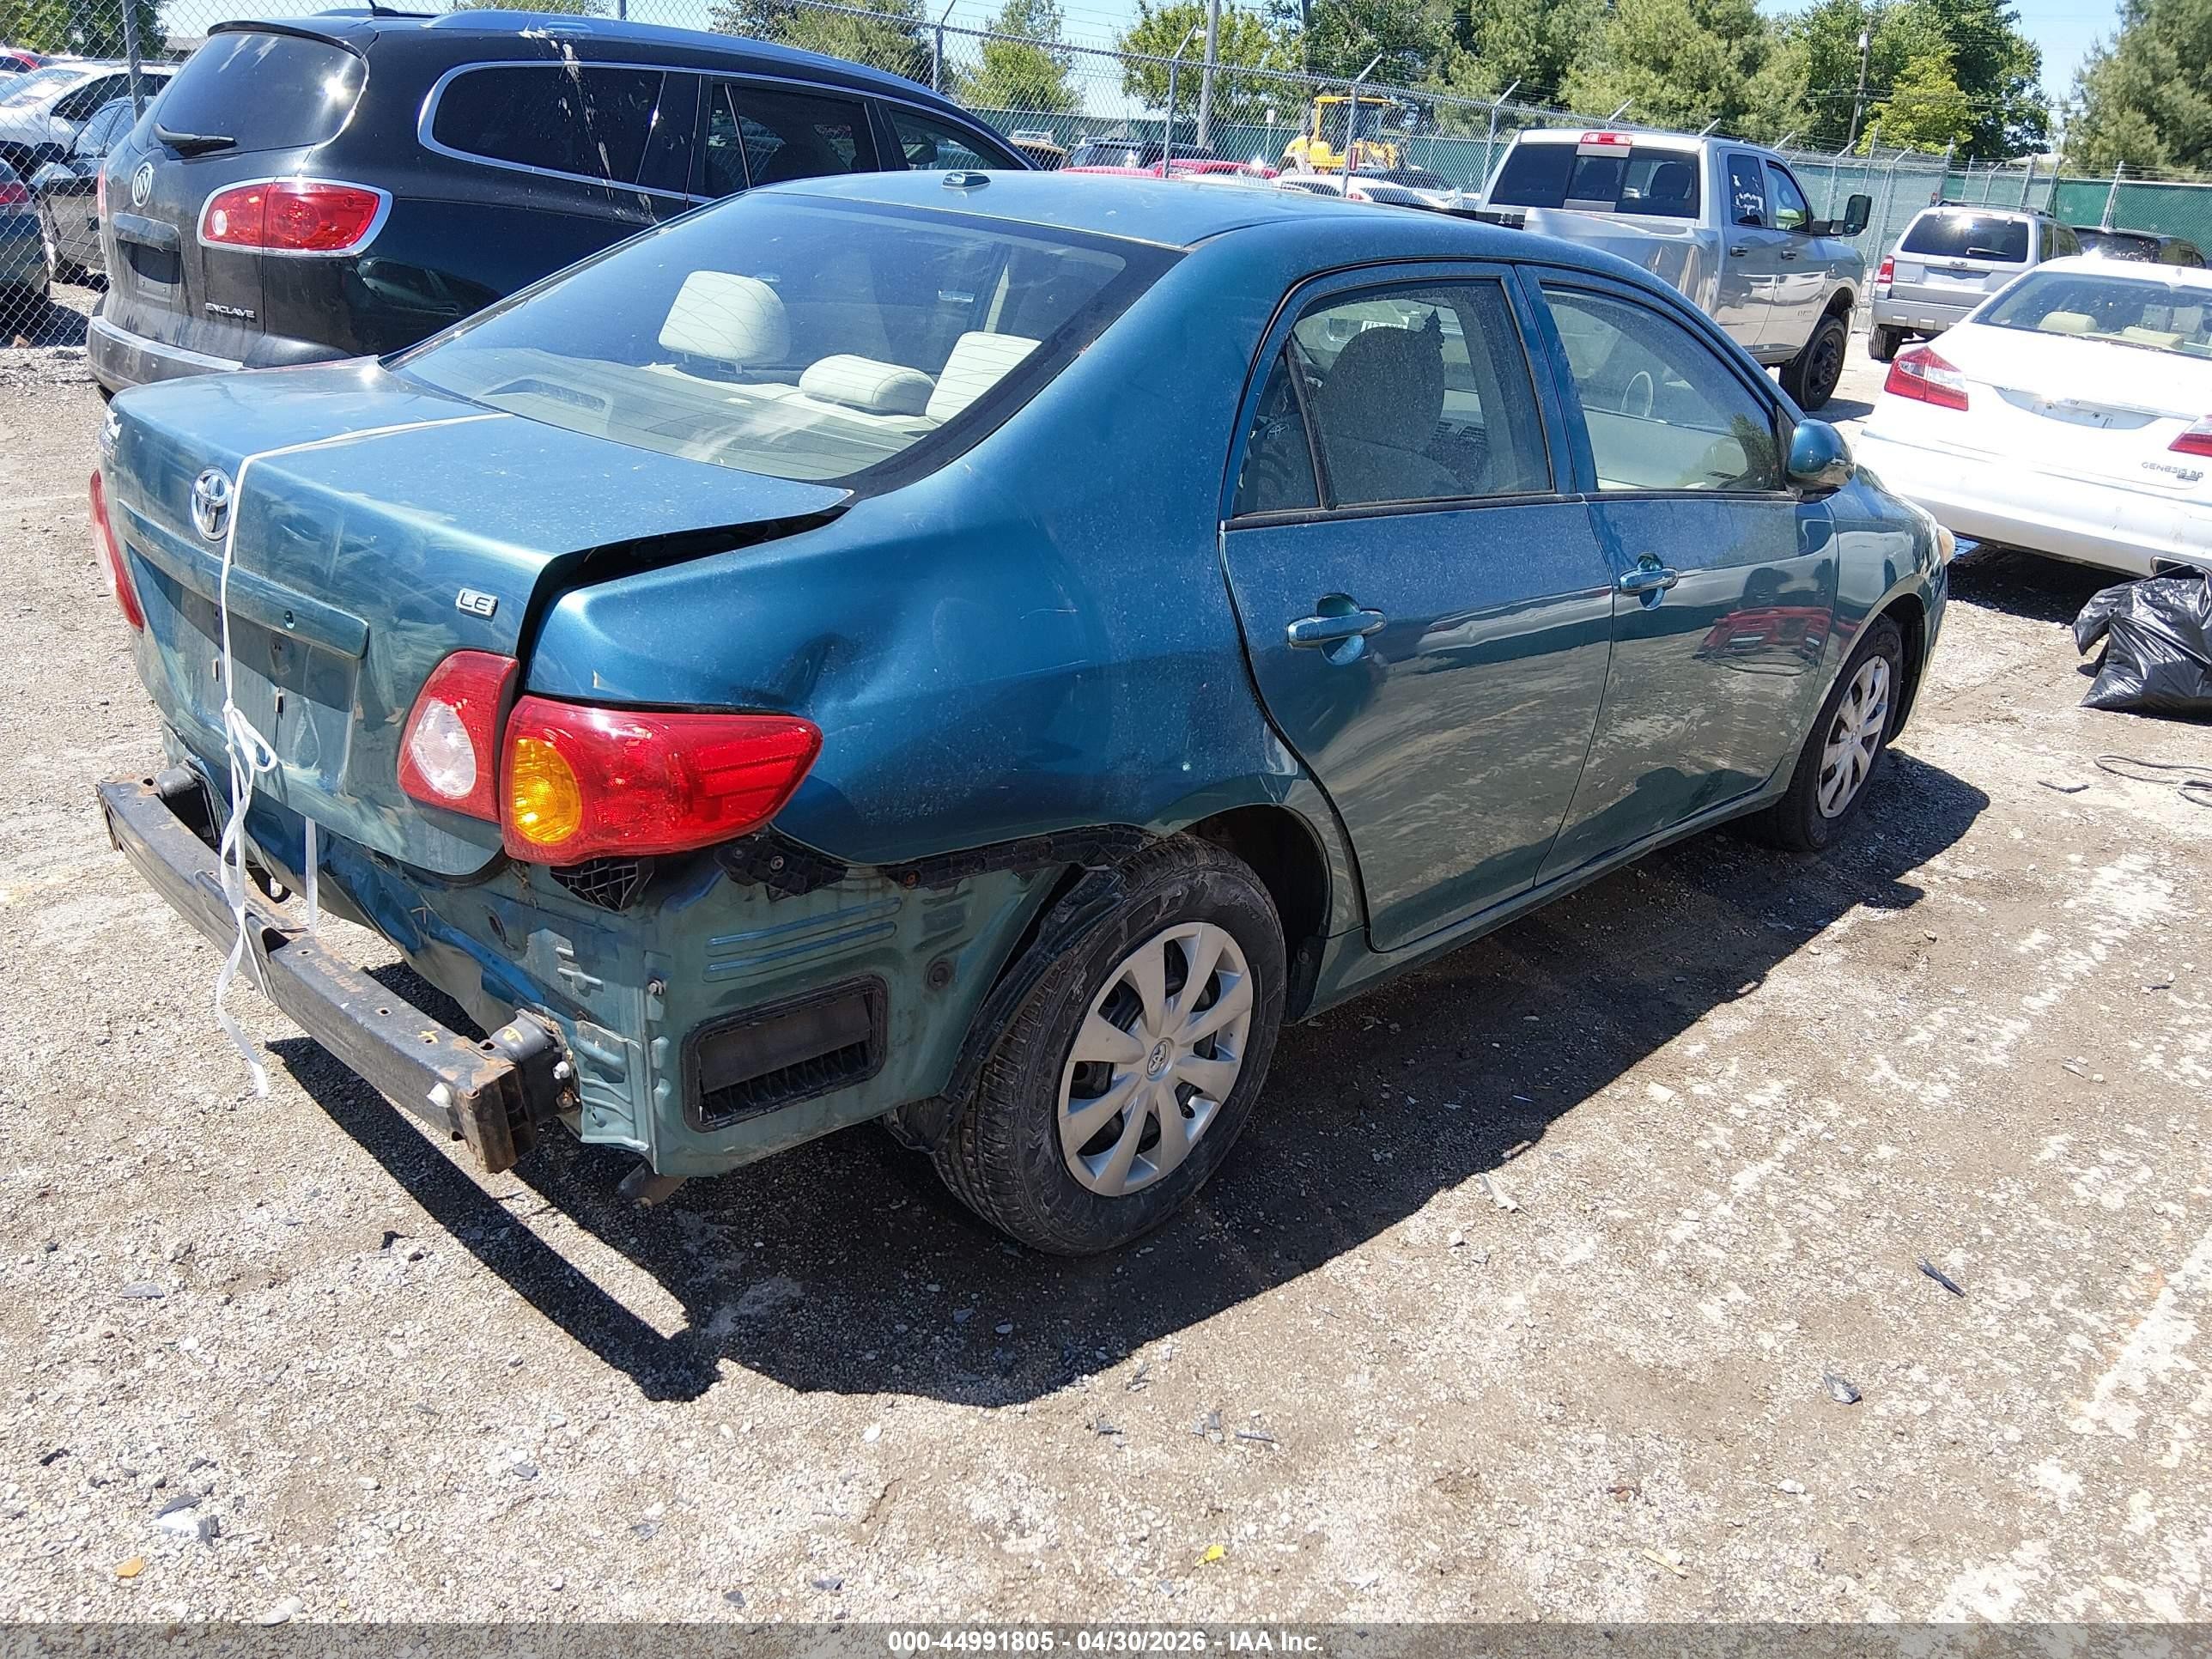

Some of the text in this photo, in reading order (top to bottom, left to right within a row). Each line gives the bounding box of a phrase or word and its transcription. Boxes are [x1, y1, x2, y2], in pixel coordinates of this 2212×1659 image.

[205, 302, 255, 319] ENCLAVE
[2142, 462, 2187, 477] GENESIS
[459, 592, 490, 612] LE
